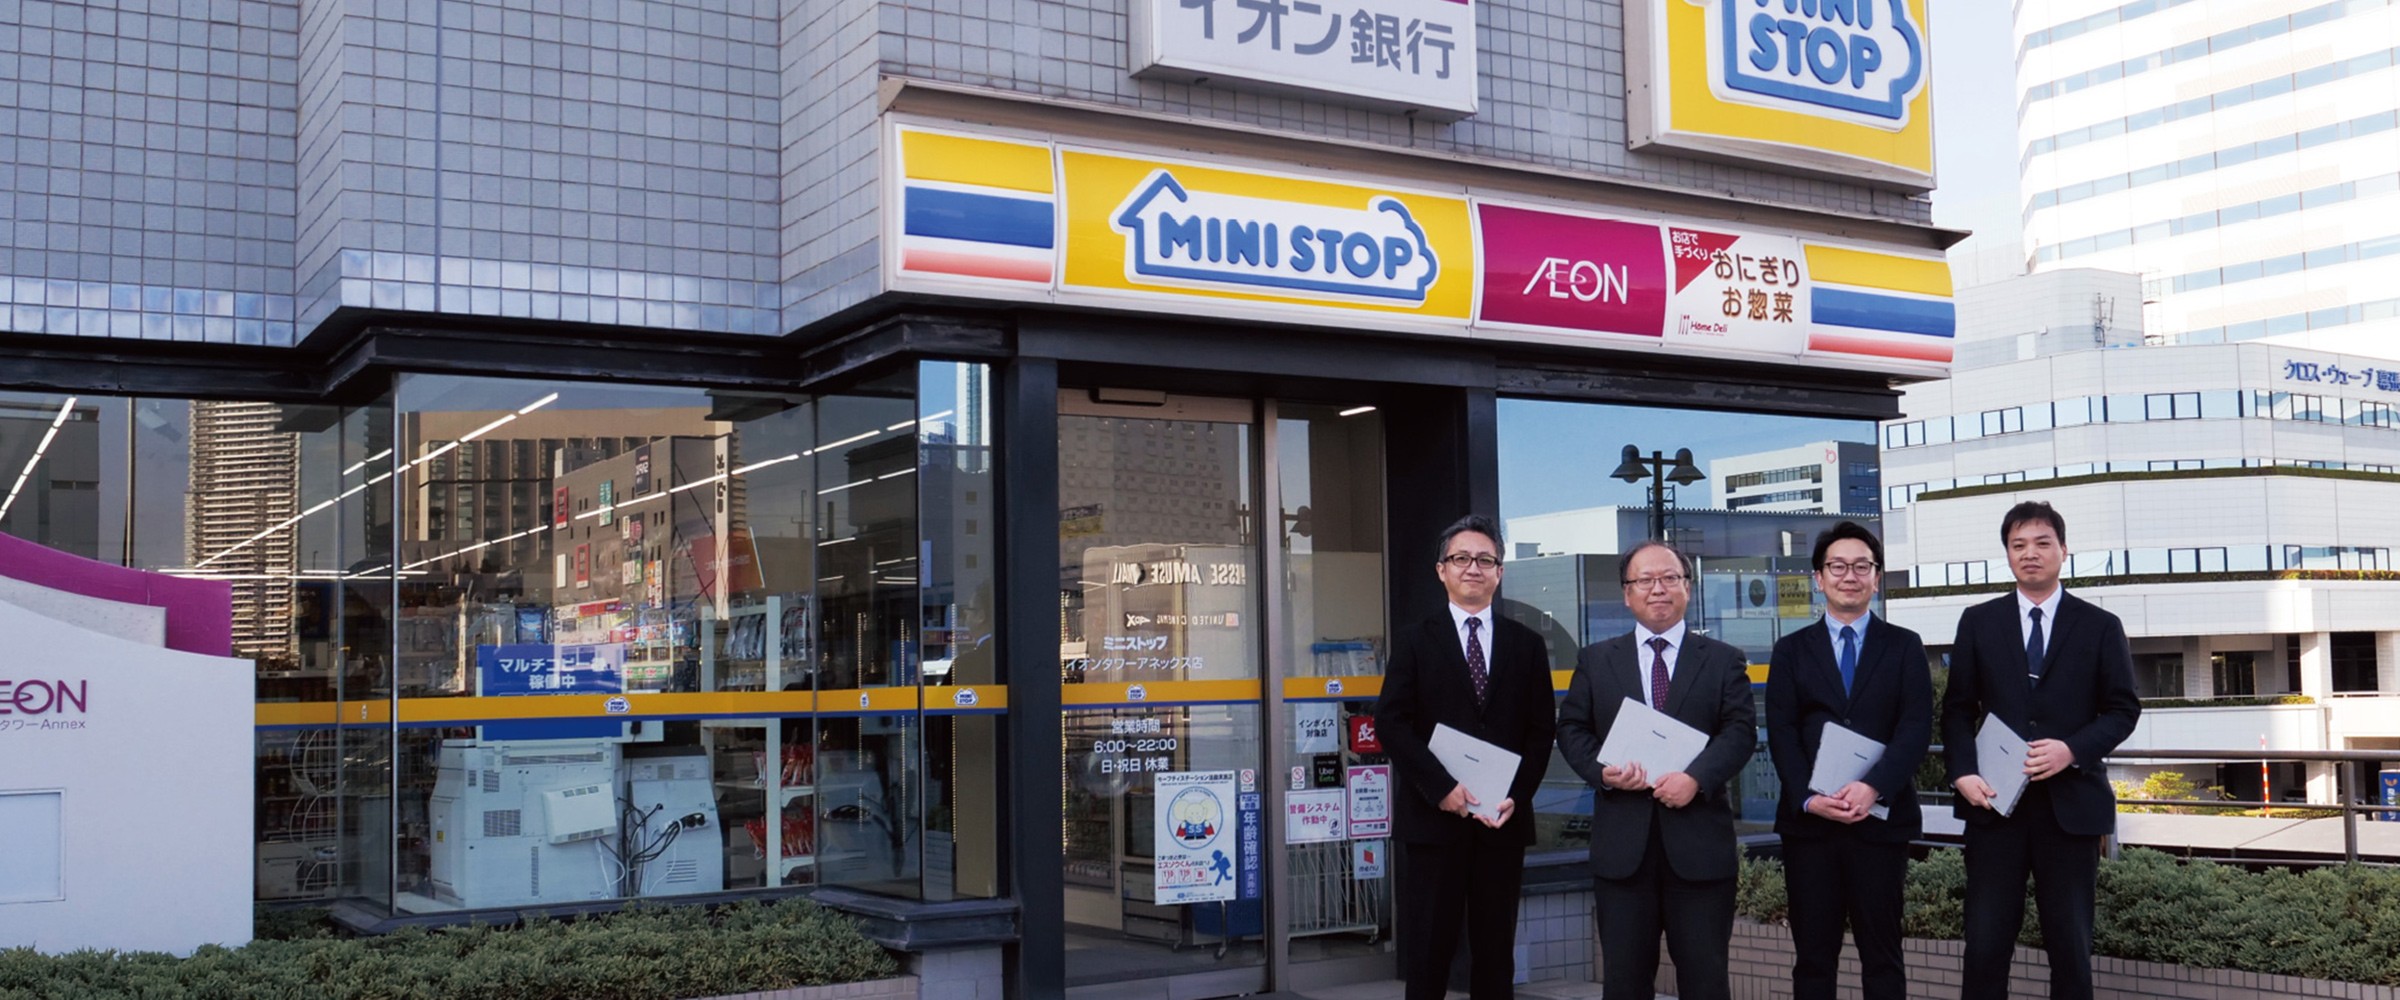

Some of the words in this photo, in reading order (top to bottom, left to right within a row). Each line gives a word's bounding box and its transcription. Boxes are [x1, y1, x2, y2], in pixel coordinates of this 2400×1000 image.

[1749, 12, 1883, 90] STOP
[1158, 211, 1278, 268] MINI
[1290, 225, 1413, 280] STOP
[1671, 230, 1699, 246] お店で
[1674, 246, 1709, 261] 手づくり
[1711, 249, 1800, 289] おにぎり
[1722, 286, 1794, 323] お惣菜
[1690, 321, 1712, 332] Home
[1713, 323, 1728, 333] Deli
[1103, 636, 1168, 651] ミニストップ
[1065, 657, 1204, 671] イオンタワーアネックス店
[1111, 719, 1160, 734] 営業時間
[1298, 719, 1336, 728] インボイス
[1318, 767, 1335, 775] Uber
[1290, 802, 1340, 814] 警備システム
[1302, 815, 1328, 825] 作動中
[1243, 811, 1258, 871] 年齢確認
